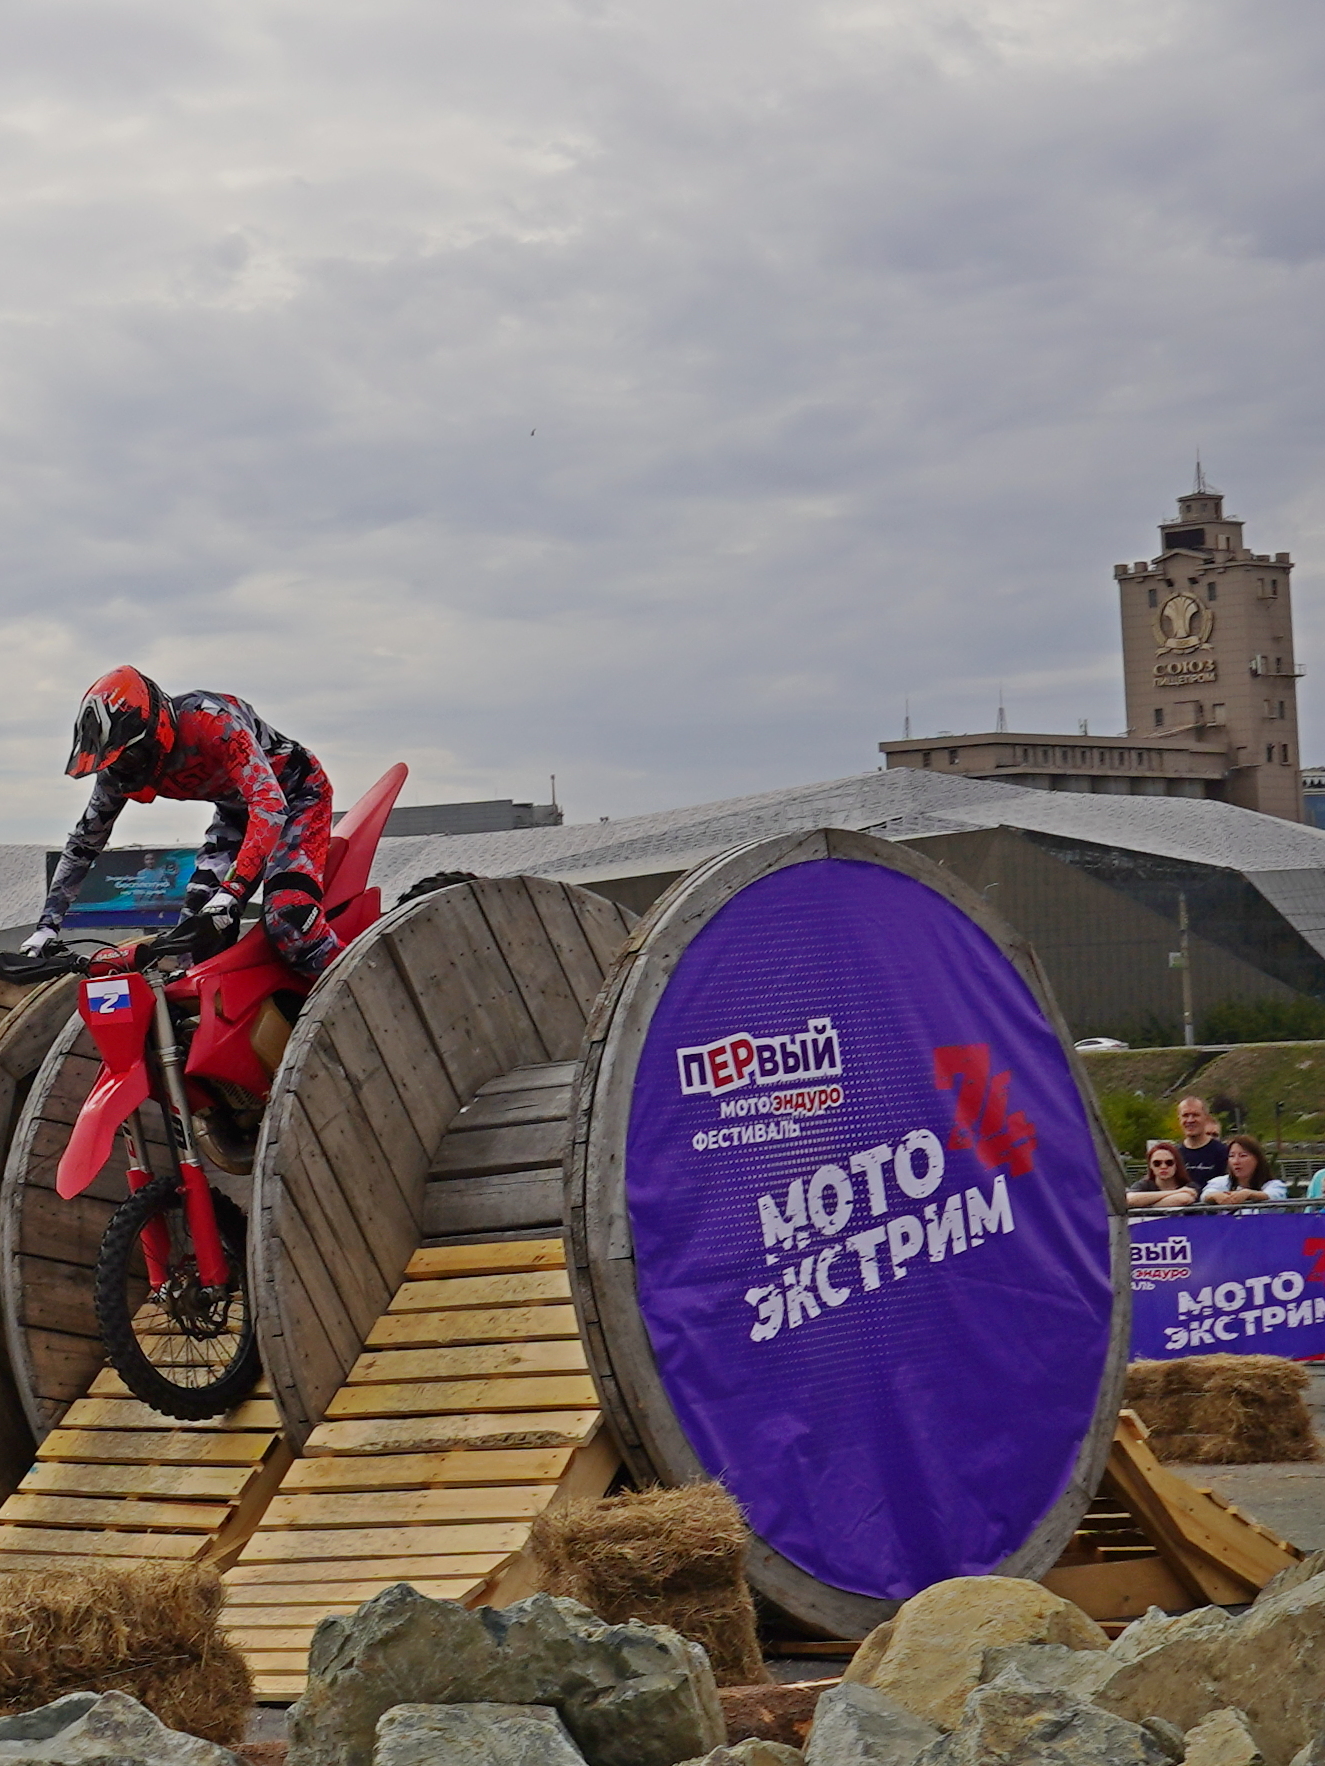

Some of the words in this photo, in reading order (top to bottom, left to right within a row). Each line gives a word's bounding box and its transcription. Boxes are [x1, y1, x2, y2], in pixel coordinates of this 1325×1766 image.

[1153, 660, 1216, 676] СОЮЗ
[99, 992, 119, 1014] 2
[681, 1022, 839, 1090] ПЕРВЫЙ
[692, 1120, 802, 1151] ФЕСТИВАЛЬ
[933, 1043, 1037, 1178] 74
[757, 1129, 945, 1266] МОТО
[744, 1174, 1015, 1343] ЭКСТРИМ
[1178, 1271, 1305, 1320] МОТО
